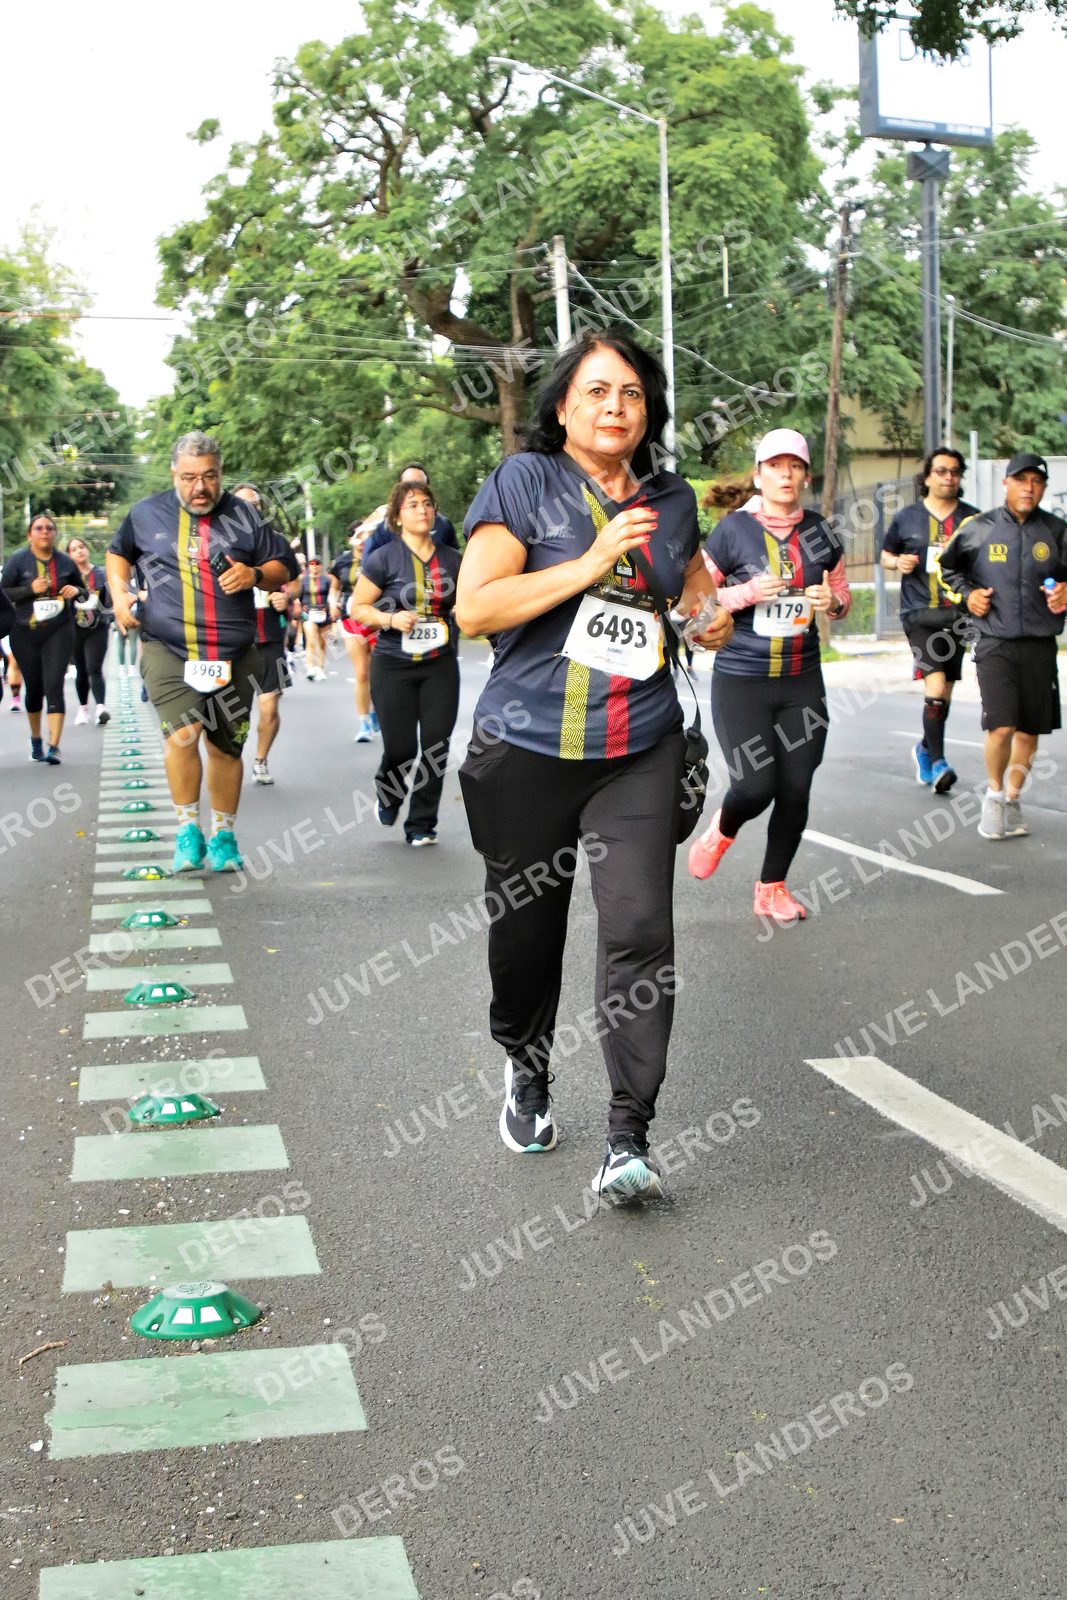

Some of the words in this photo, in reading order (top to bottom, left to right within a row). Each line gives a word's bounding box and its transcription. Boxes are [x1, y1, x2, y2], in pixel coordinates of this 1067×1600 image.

[409, 628, 438, 640] 2283
[586, 611, 648, 648] 6493
[192, 663, 222, 678] 3963
